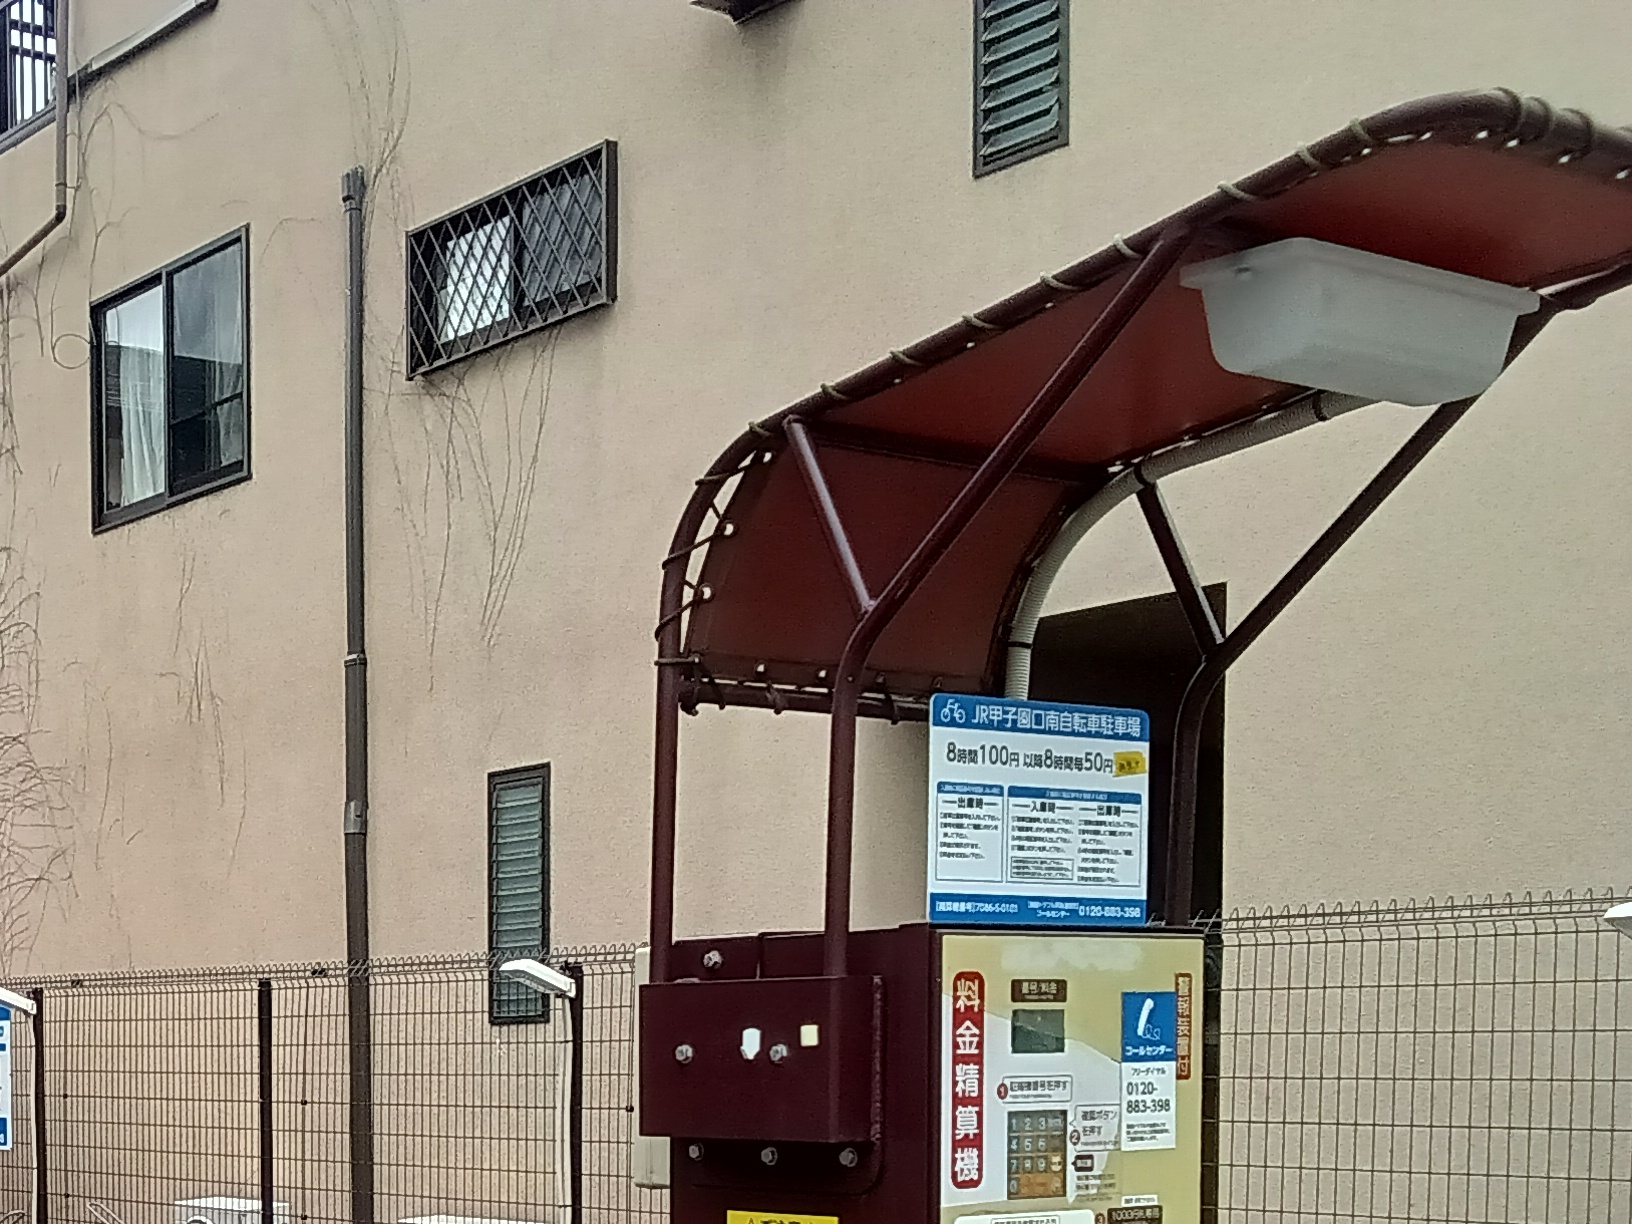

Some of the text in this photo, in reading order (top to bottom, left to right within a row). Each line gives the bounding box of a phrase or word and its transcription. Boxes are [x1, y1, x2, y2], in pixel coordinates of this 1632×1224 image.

[972, 704, 1141, 737] JR甲子園口南自転車駐車場
[946, 742, 1020, 768] 8時間100円
[1023, 748, 1114, 774] 以降8時間毎50円
[1125, 1045, 1174, 1056] コールセンター
[1131, 1066, 1166, 1076] フリーダイヤル
[954, 978, 981, 1183] 料金精算機
[1126, 1081, 1158, 1096] 0120-
[1126, 1099, 1171, 1114] 883-398
